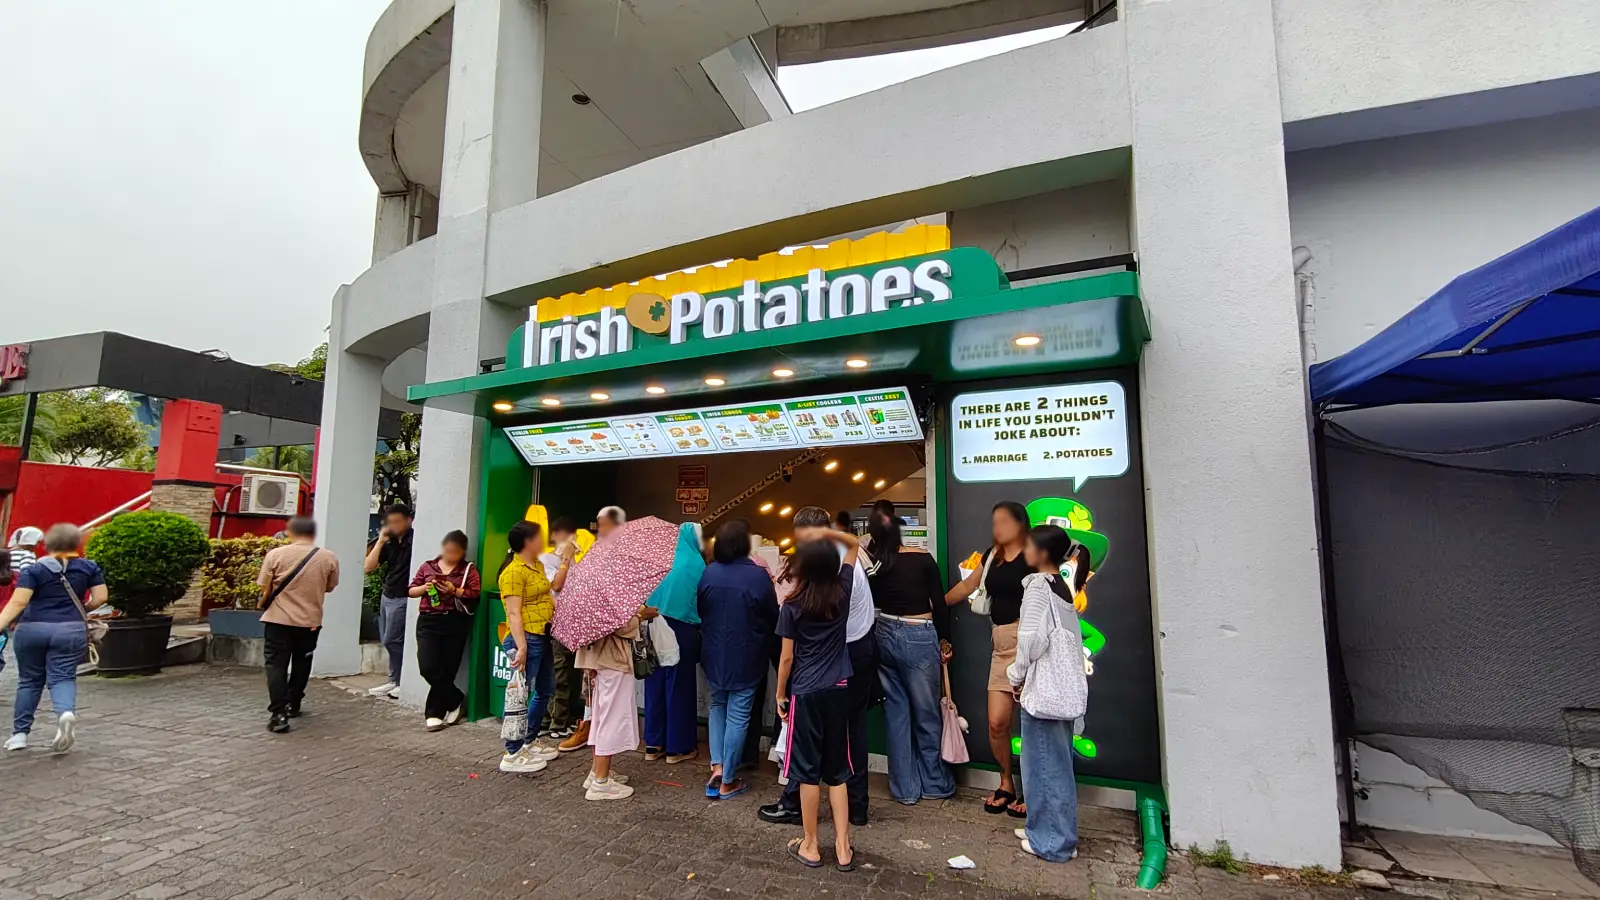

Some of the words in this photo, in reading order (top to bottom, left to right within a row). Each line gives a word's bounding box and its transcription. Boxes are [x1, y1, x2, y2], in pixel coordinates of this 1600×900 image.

[523, 305, 632, 369] Irish
[669, 258, 953, 345] Potatoes
[960, 403, 1001, 416] THERE
[1004, 401, 1031, 413] ARE
[1036, 397, 1049, 410] 2
[1054, 395, 1108, 409] THINGS
[958, 419, 972, 430] IN
[975, 417, 1001, 429] LIFE
[1004, 415, 1031, 427] YOU
[1034, 409, 1115, 425] SHOULDN'T
[994, 430, 1026, 441] JOKE
[1029, 426, 1081, 439] ABOUT:
[962, 456, 972, 464] 1.
[973, 453, 1028, 464] MARRIAGE
[1043, 451, 1054, 460] 2.
[1056, 447, 1113, 459] POTATOES
